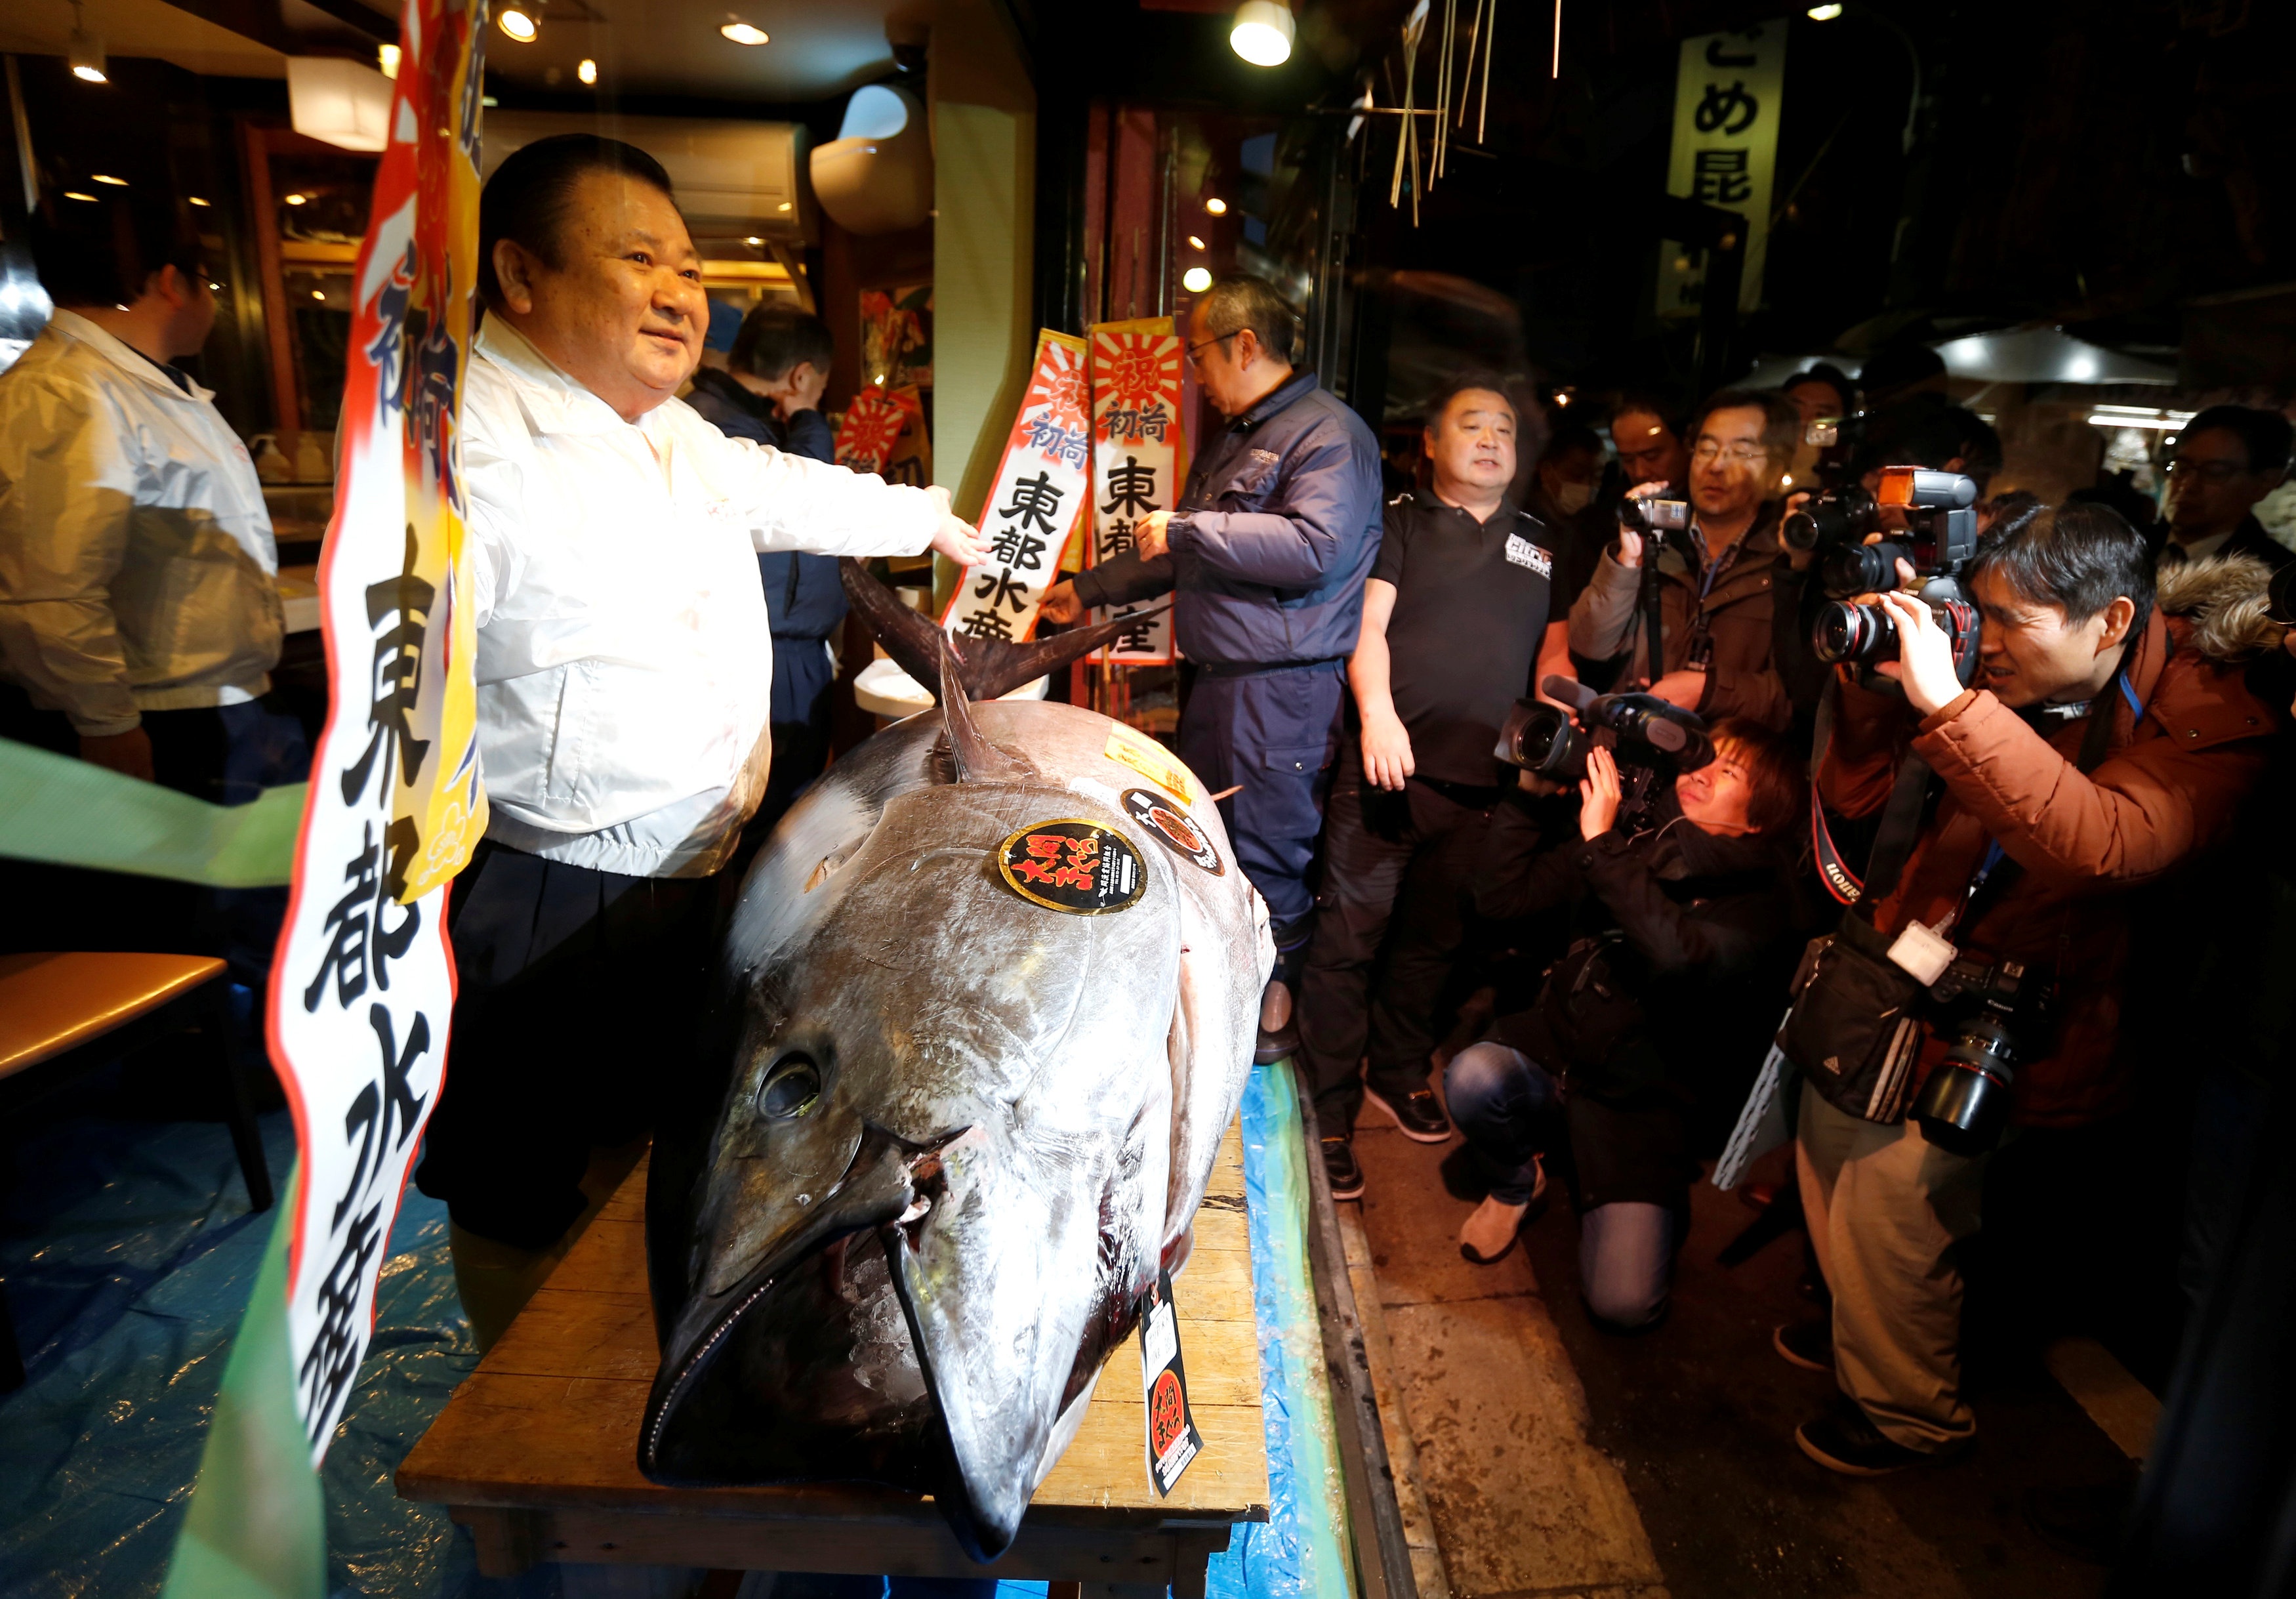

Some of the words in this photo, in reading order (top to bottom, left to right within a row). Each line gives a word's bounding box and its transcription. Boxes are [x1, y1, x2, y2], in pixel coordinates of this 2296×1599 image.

[1023, 411, 1089, 470] 初荷
[1099, 400, 1168, 442] 初荷
[1011, 834, 1067, 884] 大間
[1056, 837, 1100, 891] まぐろ
[1826, 863, 1860, 903] anon
[299, 523, 436, 1445] 東都水産
[1987, 999, 2013, 1012] Canon
[1155, 1382, 1177, 1422] 大間
[1157, 1407, 1181, 1449] まぐろ
